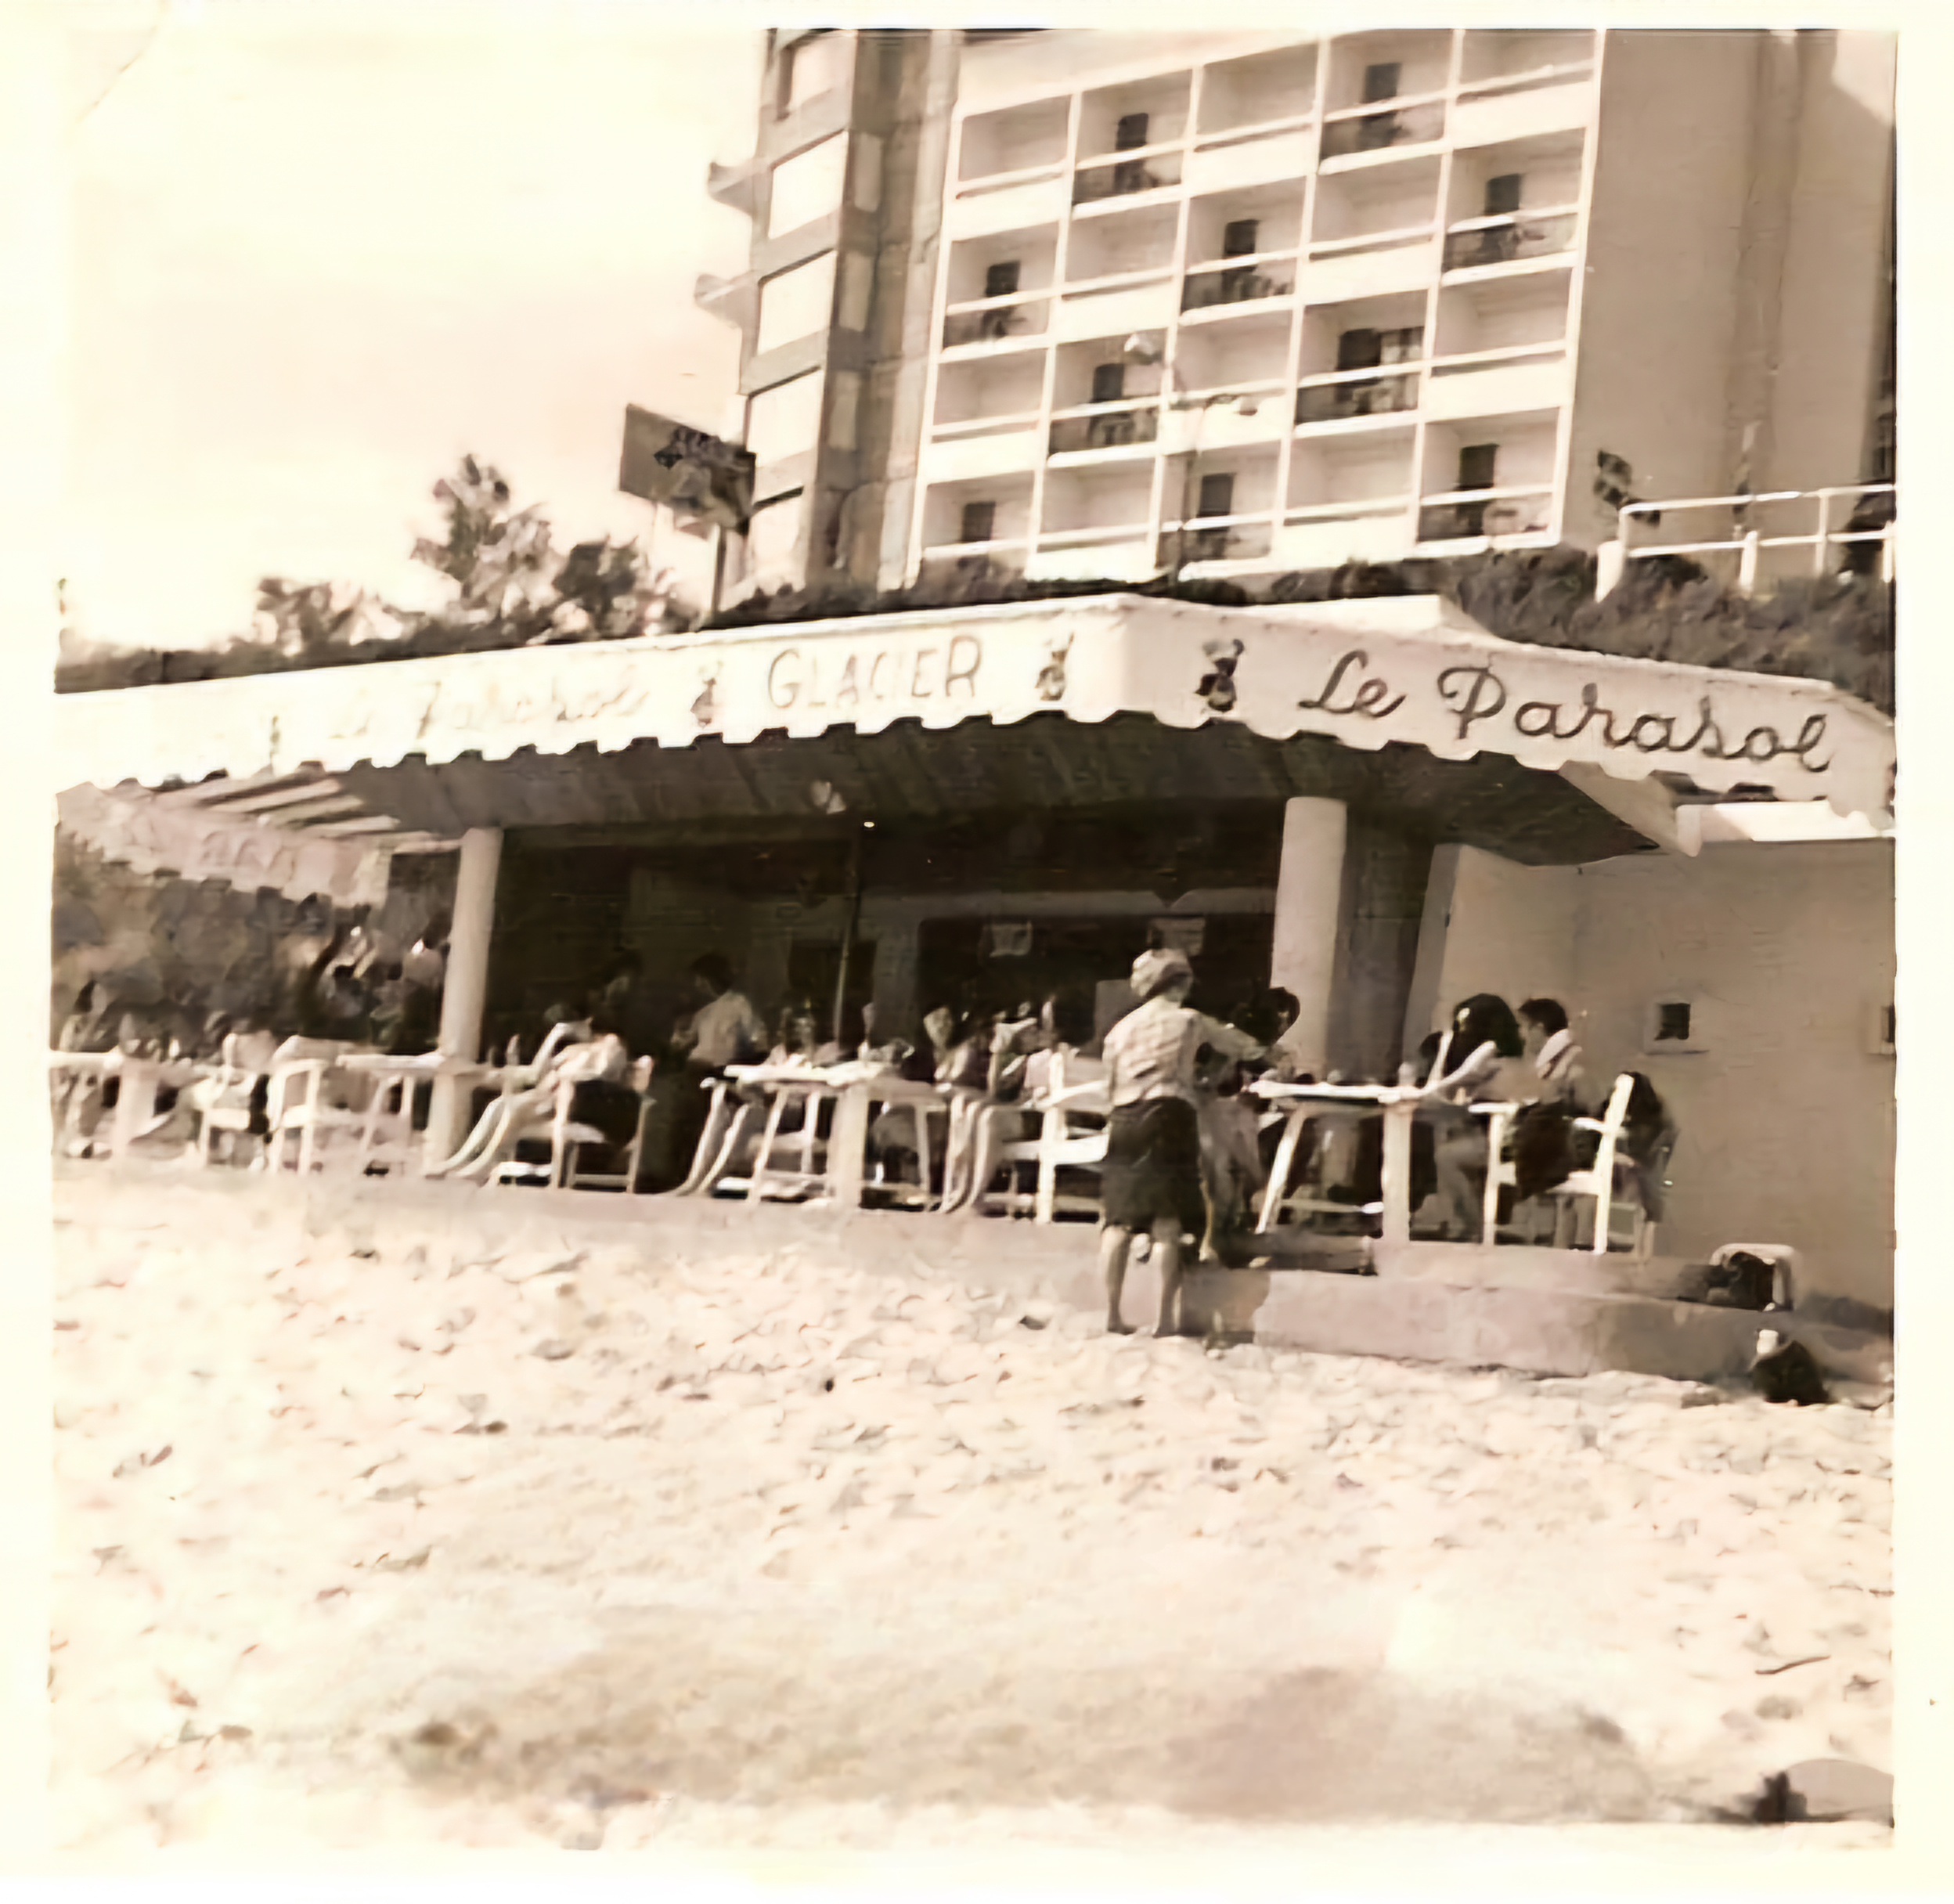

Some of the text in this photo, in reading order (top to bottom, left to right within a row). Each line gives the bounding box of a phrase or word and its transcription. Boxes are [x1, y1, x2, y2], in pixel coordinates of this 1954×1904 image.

[767, 635, 982, 709] GLACIER
[1299, 650, 1831, 772] Le Parasol
